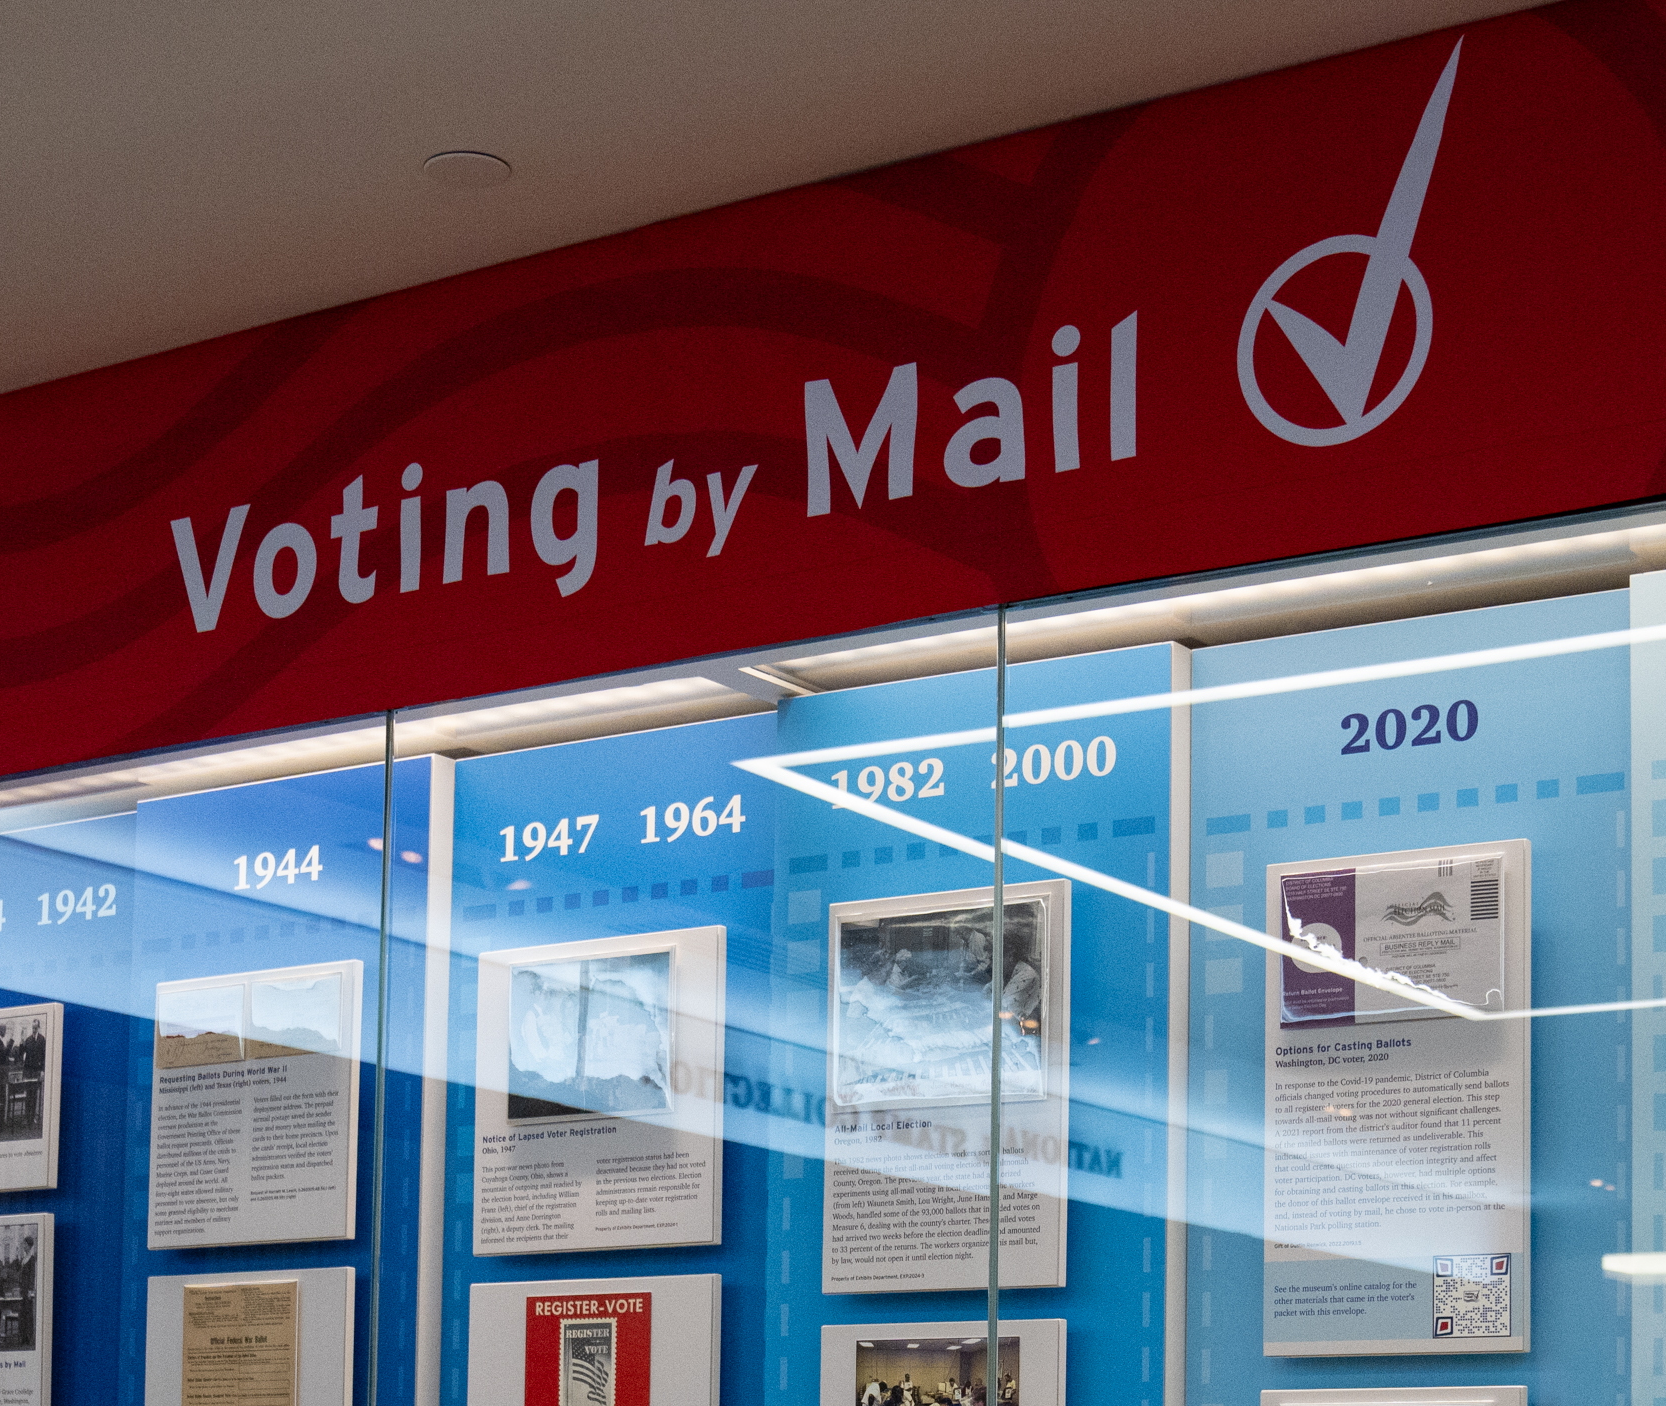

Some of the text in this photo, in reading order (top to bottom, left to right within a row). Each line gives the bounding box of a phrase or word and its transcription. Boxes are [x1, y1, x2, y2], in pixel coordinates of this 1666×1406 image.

[171, 309, 1138, 633] Voting by Mail
[1341, 700, 1478, 755] 2020
[990, 736, 1118, 790] 2000
[831, 759, 945, 809] 1982
[641, 795, 745, 843] 1964
[500, 814, 599, 862] 1947
[232, 845, 323, 892] 1944
[38, 884, 116, 925] 1942
[1274, 1053, 1390, 1069] Washington, DC voter, 2020
[1275, 1037, 1412, 1058] Options for Casting Ballots
[159, 1074, 196, 1085] Requesting
[197, 1072, 221, 1081] Ballots
[222, 1070, 245, 1079] During
[246, 1067, 266, 1076] World
[267, 1066, 280, 1074] War
[482, 1126, 617, 1144] Notice of Lapsed Voter Registration
[834, 1119, 932, 1134] All-Mail Local Election
[535, 1298, 643, 1316] REGISTER-VOTE
[565, 1328, 610, 1339] REGISTER
[583, 1345, 609, 1355] VOTE
